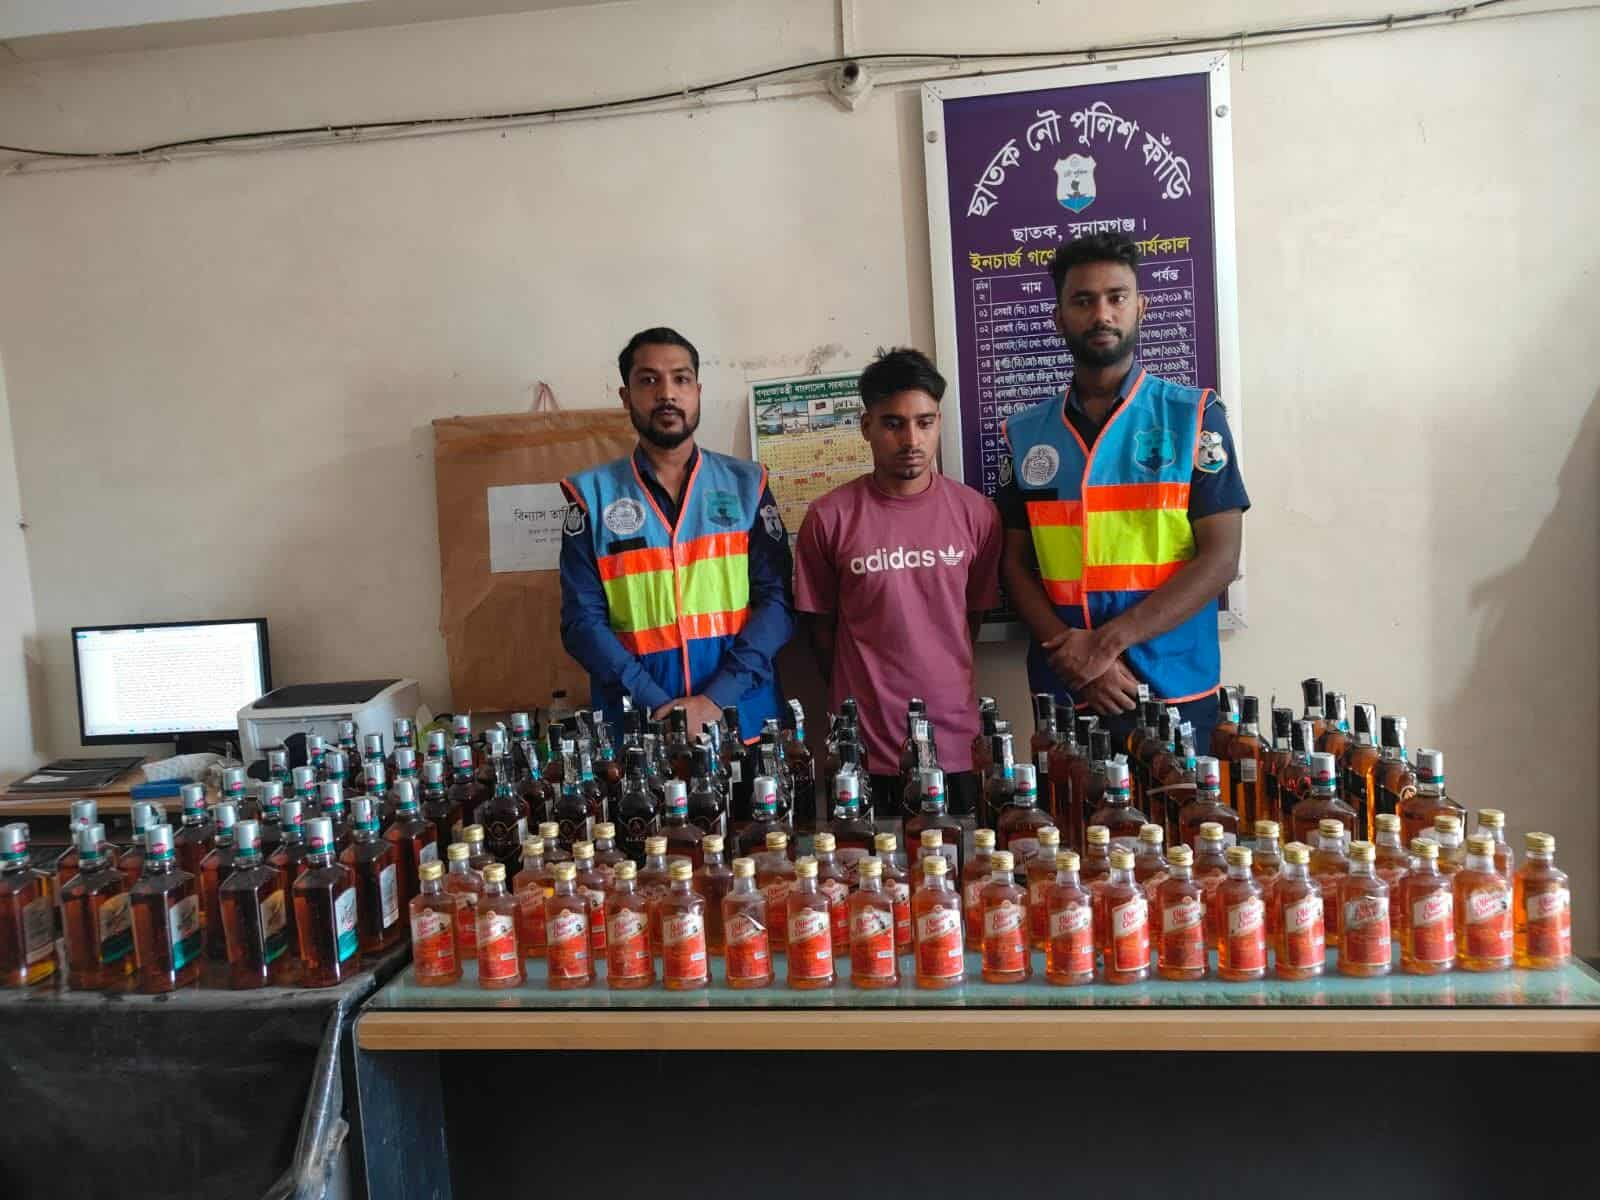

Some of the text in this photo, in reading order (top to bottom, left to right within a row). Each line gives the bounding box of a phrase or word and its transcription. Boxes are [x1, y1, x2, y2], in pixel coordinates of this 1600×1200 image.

[967, 138, 1021, 217] ছাতক
[1026, 109, 1062, 152] নৌ
[1070, 100, 1140, 150] পুলিশ
[1011, 224, 1063, 244] ছাতক,
[968, 246, 1024, 273] ইনচার্জ
[1020, 281, 1043, 295] নাম
[850, 546, 936, 575] adidas
